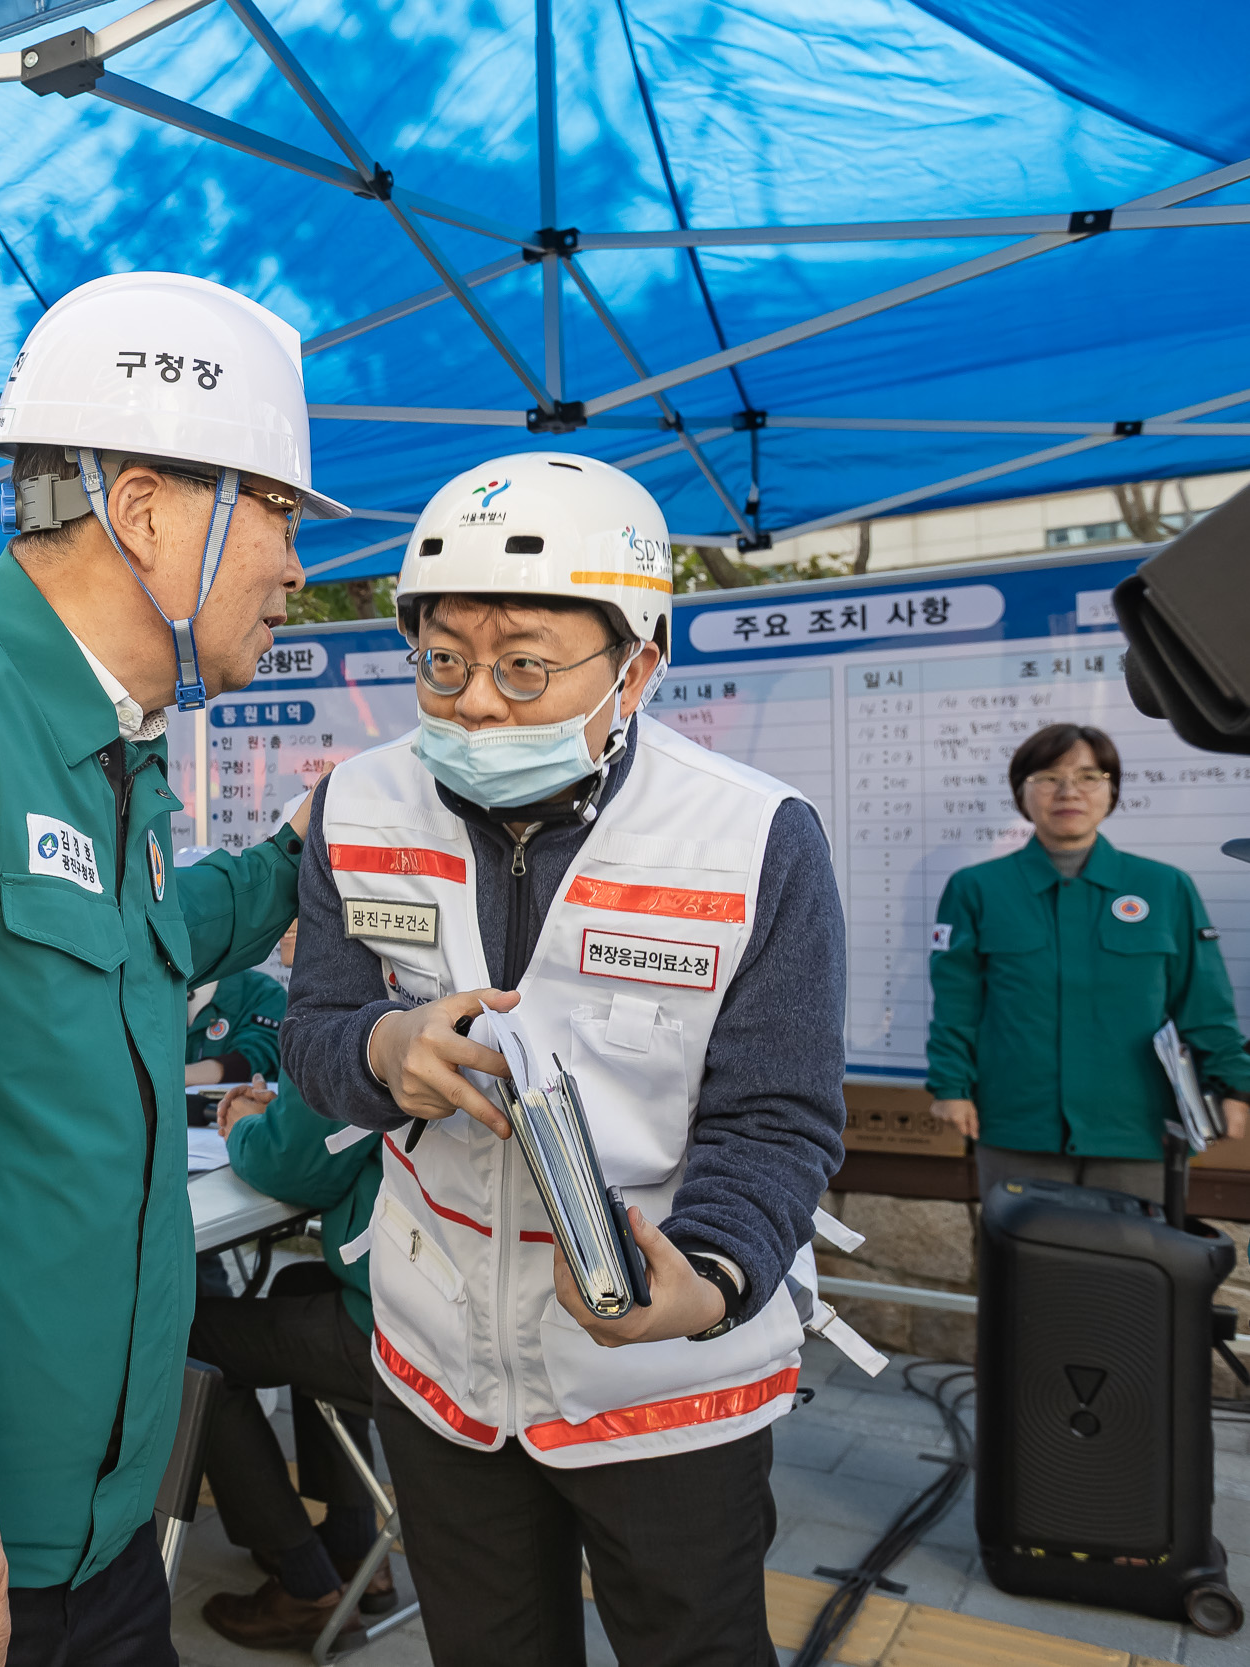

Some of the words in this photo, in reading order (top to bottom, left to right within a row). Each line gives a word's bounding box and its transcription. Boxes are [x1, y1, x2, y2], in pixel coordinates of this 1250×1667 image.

[115, 351, 224, 390] 구청장
[460, 511, 507, 522] 서울특별시
[733, 612, 791, 642] 주요
[808, 602, 867, 635] 조치
[886, 595, 952, 628] 사항
[257, 648, 315, 674] 상황판
[863, 670, 903, 689] 일시
[60, 829, 93, 863] 김경호
[61, 853, 95, 884] 광진구청장
[352, 909, 430, 933] 광진구보건소
[589, 943, 710, 976] 현장응급의료소장
